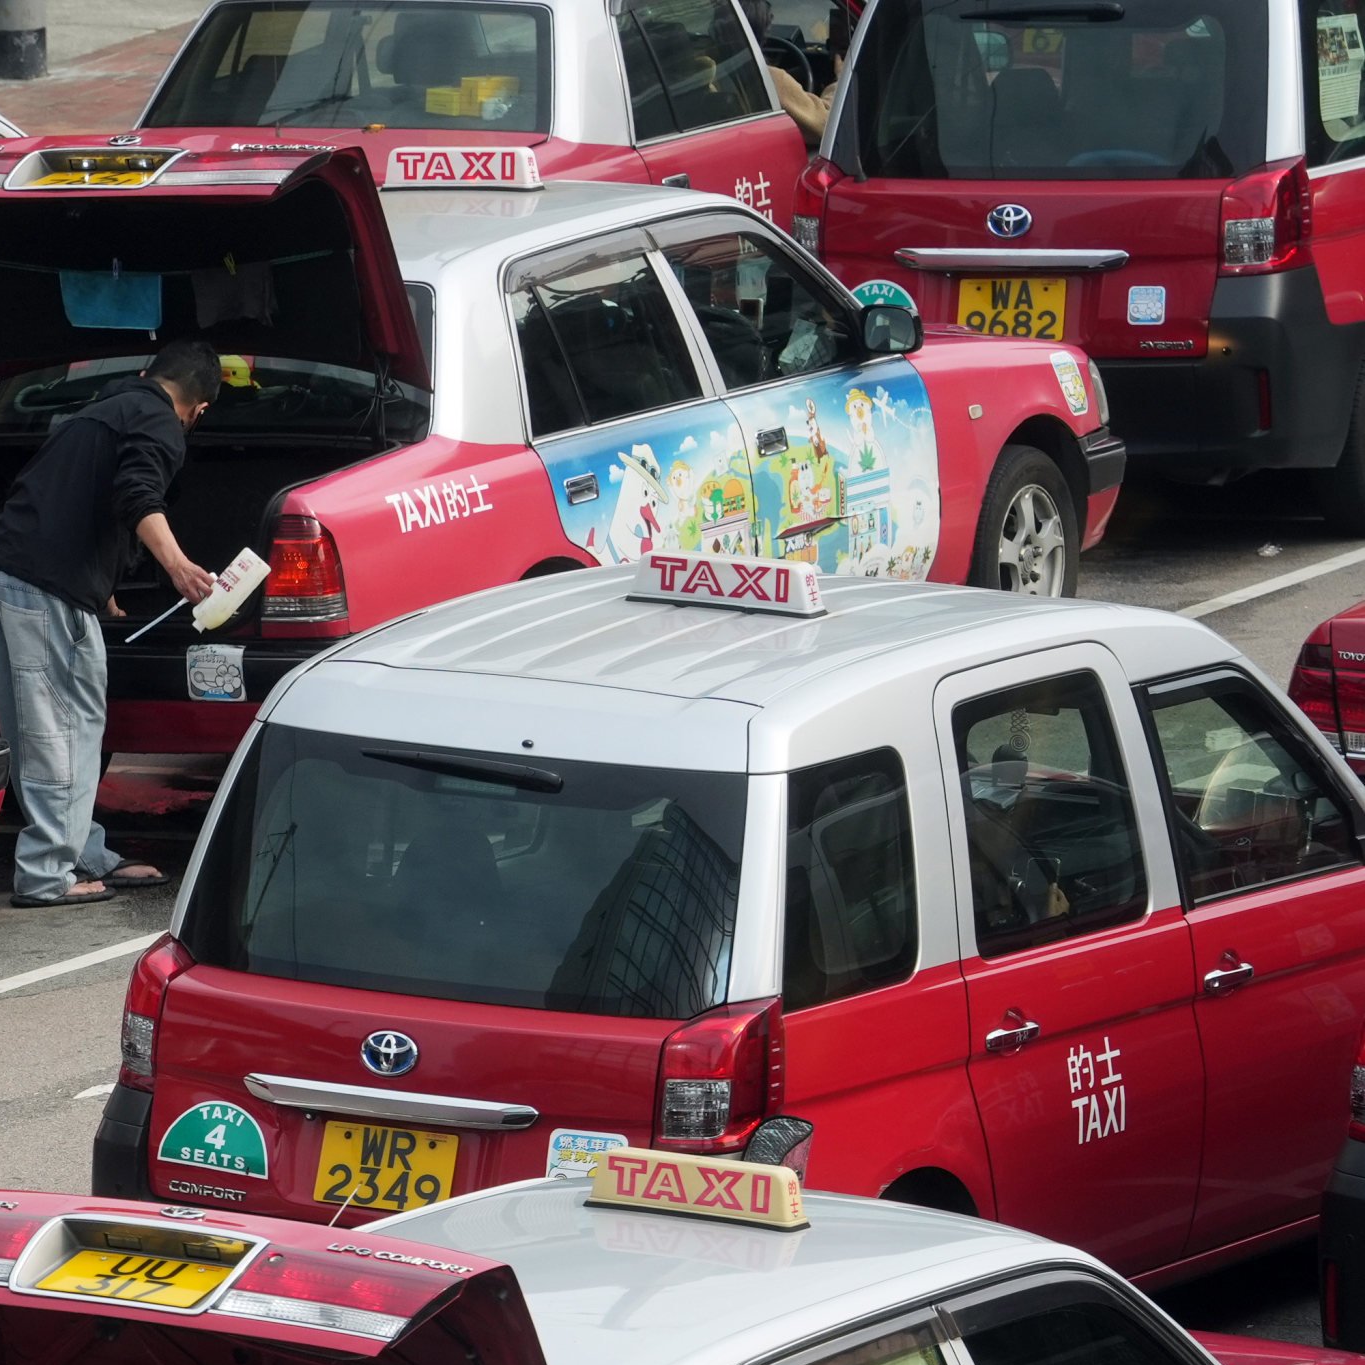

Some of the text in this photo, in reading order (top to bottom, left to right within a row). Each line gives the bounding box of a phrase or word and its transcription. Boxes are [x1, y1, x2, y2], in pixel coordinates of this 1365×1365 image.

[396, 151, 515, 181] TAXI
[735, 171, 771, 208] 的士
[862, 285, 895, 298] TAXI
[990, 280, 1032, 309] WA
[965, 310, 1056, 340] 9682
[648, 555, 790, 602] TAXI
[1337, 650, 1365, 662] TOYO
[1066, 1036, 1122, 1093] 的士
[198, 1105, 246, 1128] TAXI
[1070, 1085, 1126, 1145] TAXI
[204, 1123, 227, 1150] 4
[359, 1126, 417, 1171] WR
[179, 1146, 246, 1170] SEATS
[168, 1179, 246, 1202] COMFORT
[322, 1163, 441, 1211] 2349
[606, 1155, 771, 1214] TAXI
[110, 1256, 189, 1281] UU
[326, 1242, 473, 1275] LPG COMFORT
[77, 1275, 174, 1300] 317
